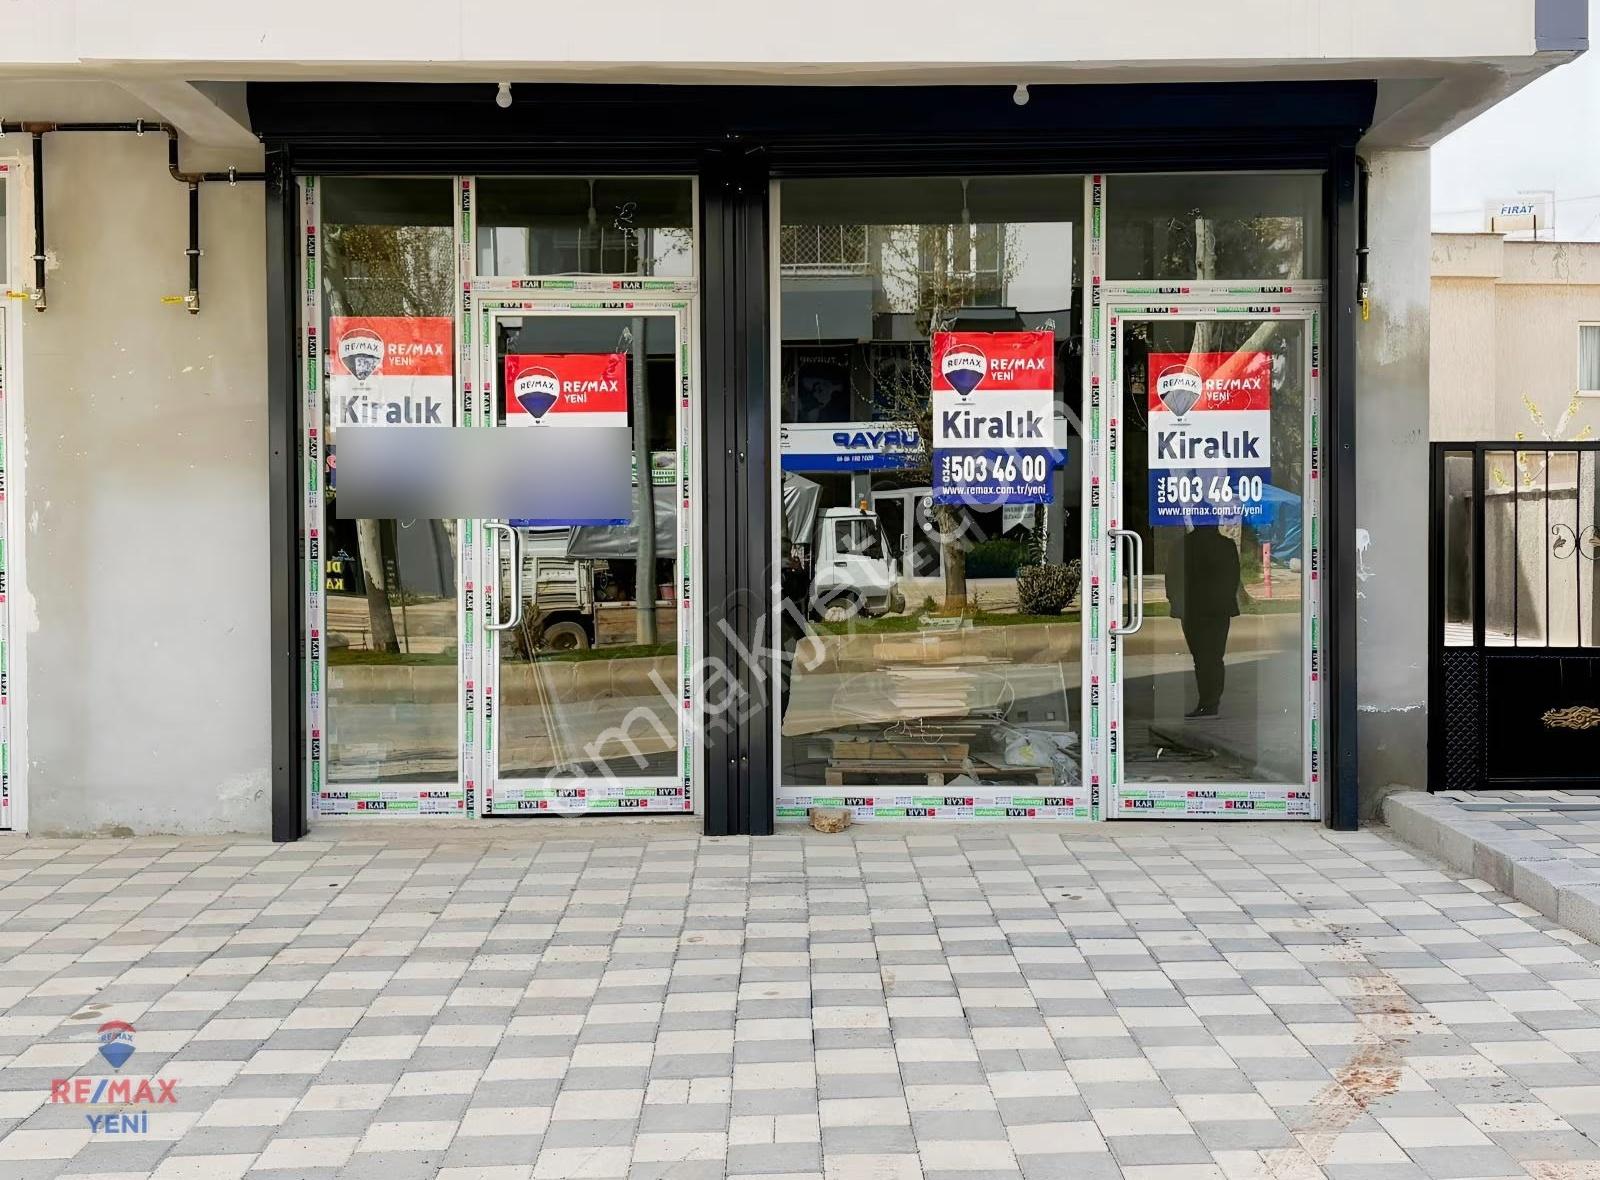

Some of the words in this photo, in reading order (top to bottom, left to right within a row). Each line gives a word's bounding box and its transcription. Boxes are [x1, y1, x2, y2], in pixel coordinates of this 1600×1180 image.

[1501, 205, 1533, 214] FIRAT
[308, 236, 316, 255] KAR
[522, 280, 540, 288] KAR
[623, 281, 641, 289] KAR
[308, 338, 316, 356] KAR
[344, 341, 379, 352] RE/MAX
[387, 343, 444, 355] RE/MAX
[388, 355, 412, 366] YENİ
[947, 357, 982, 368] RE/MAX
[990, 358, 1046, 370] RE/MAX
[991, 370, 1014, 381] YENİ
[520, 380, 554, 391] RE/MAX
[563, 379, 619, 392] RE/MAX
[1162, 378, 1197, 389] RE/MAX
[1205, 378, 1262, 390] RE/MAX
[464, 392, 472, 410] KAR
[564, 393, 587, 404] YENİ
[1206, 390, 1230, 401] YENİ
[340, 395, 442, 424] Kiralık
[942, 410, 1044, 439] Kiralık
[309, 438, 317, 456] KAR
[1157, 430, 1260, 459] Kiralık
[942, 456, 950, 483] 0344
[951, 455, 988, 482] 503
[992, 455, 1017, 482] 46
[1021, 454, 1046, 482] 00
[1157, 477, 1166, 503] 0344
[1167, 476, 1203, 503] 503
[1208, 475, 1233, 502] 46
[1238, 475, 1263, 502] 00
[466, 691, 474, 709] KAR
[558, 789, 576, 797] KAR
[658, 788, 677, 796] KAR
[519, 801, 537, 809] KAR
[620, 799, 638, 807] KAR
[847, 797, 864, 806] KAR
[946, 797, 964, 806] KAR
[1046, 797, 1065, 806] KAR
[1135, 800, 1153, 808] KAR
[1235, 801, 1253, 809] KAR
[908, 808, 926, 817] KAR
[1009, 808, 1026, 817] KAR
